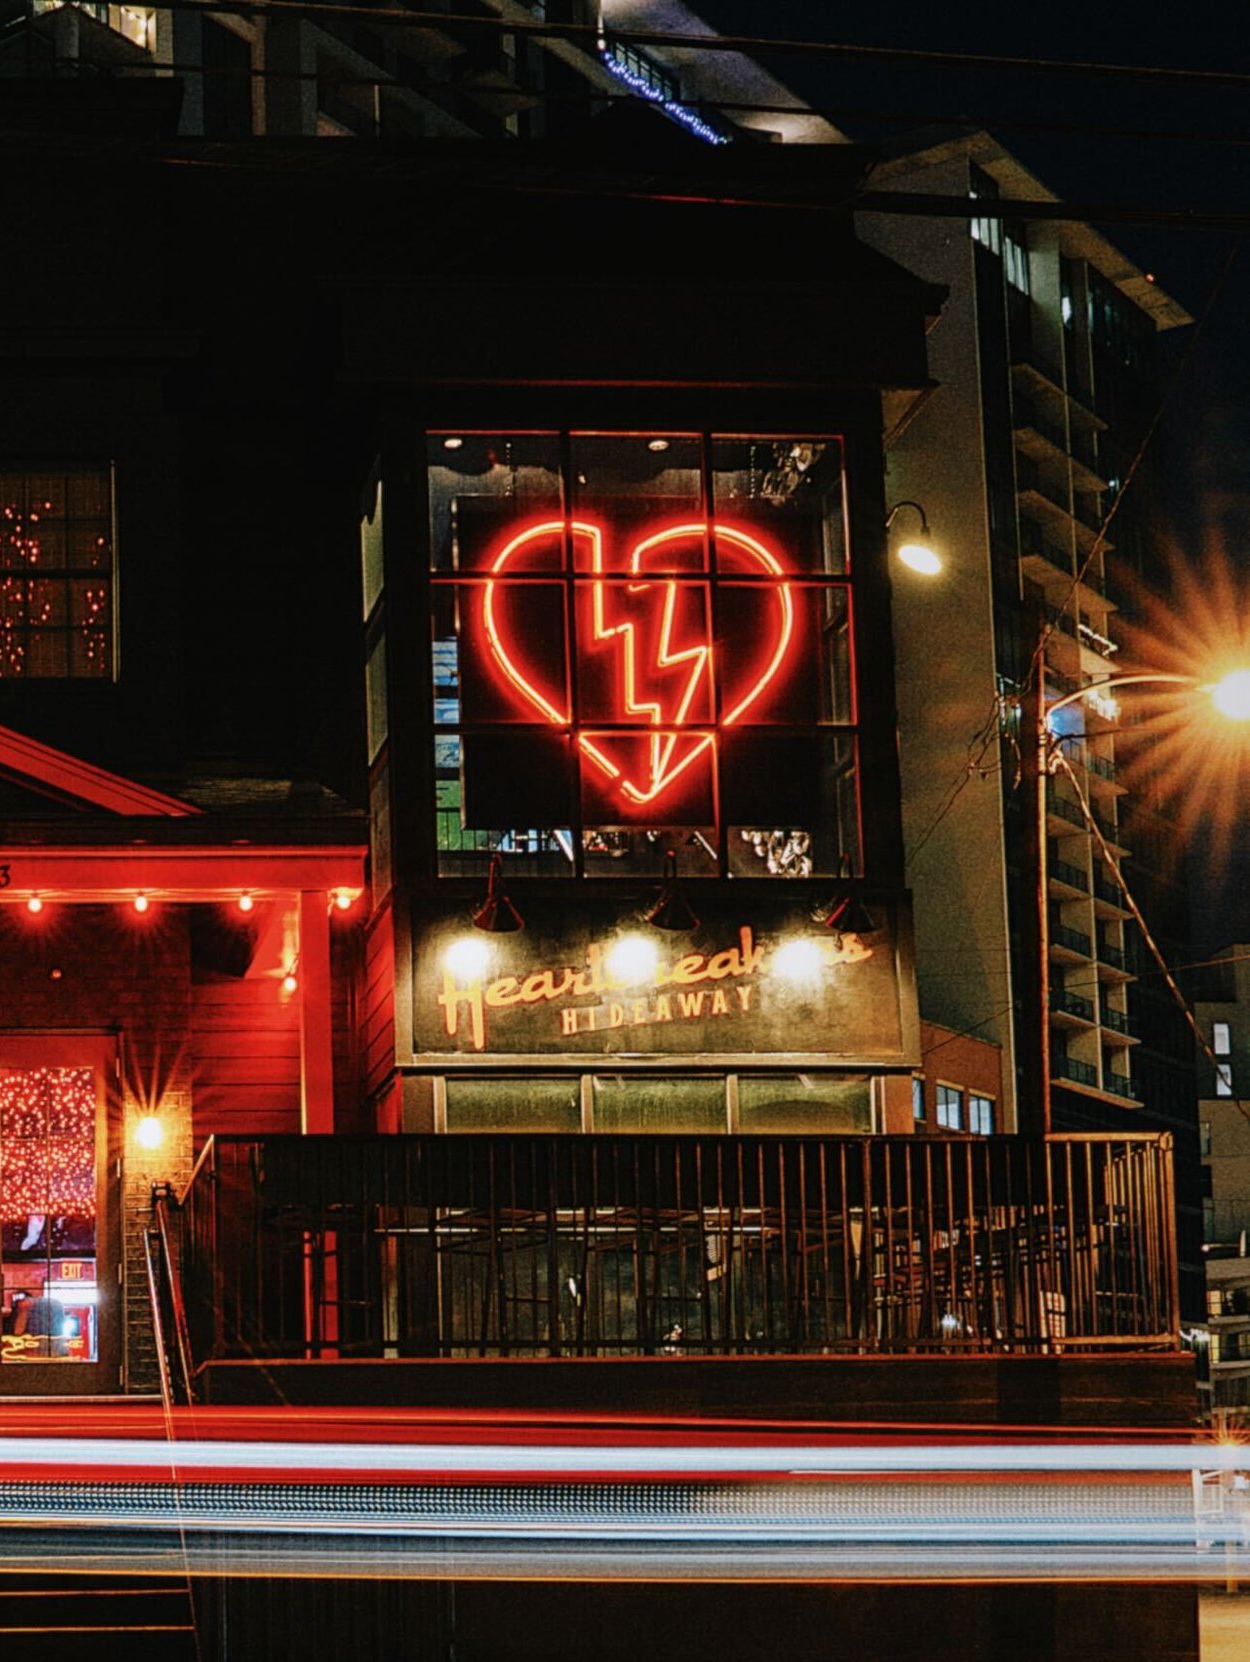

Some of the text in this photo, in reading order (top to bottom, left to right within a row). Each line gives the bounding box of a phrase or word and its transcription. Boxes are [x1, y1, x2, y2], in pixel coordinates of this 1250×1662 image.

[437, 926, 874, 1050] Hearteaks
[561, 984, 752, 1035] HIDEAWAY
[61, 1262, 82, 1278] EXIT
